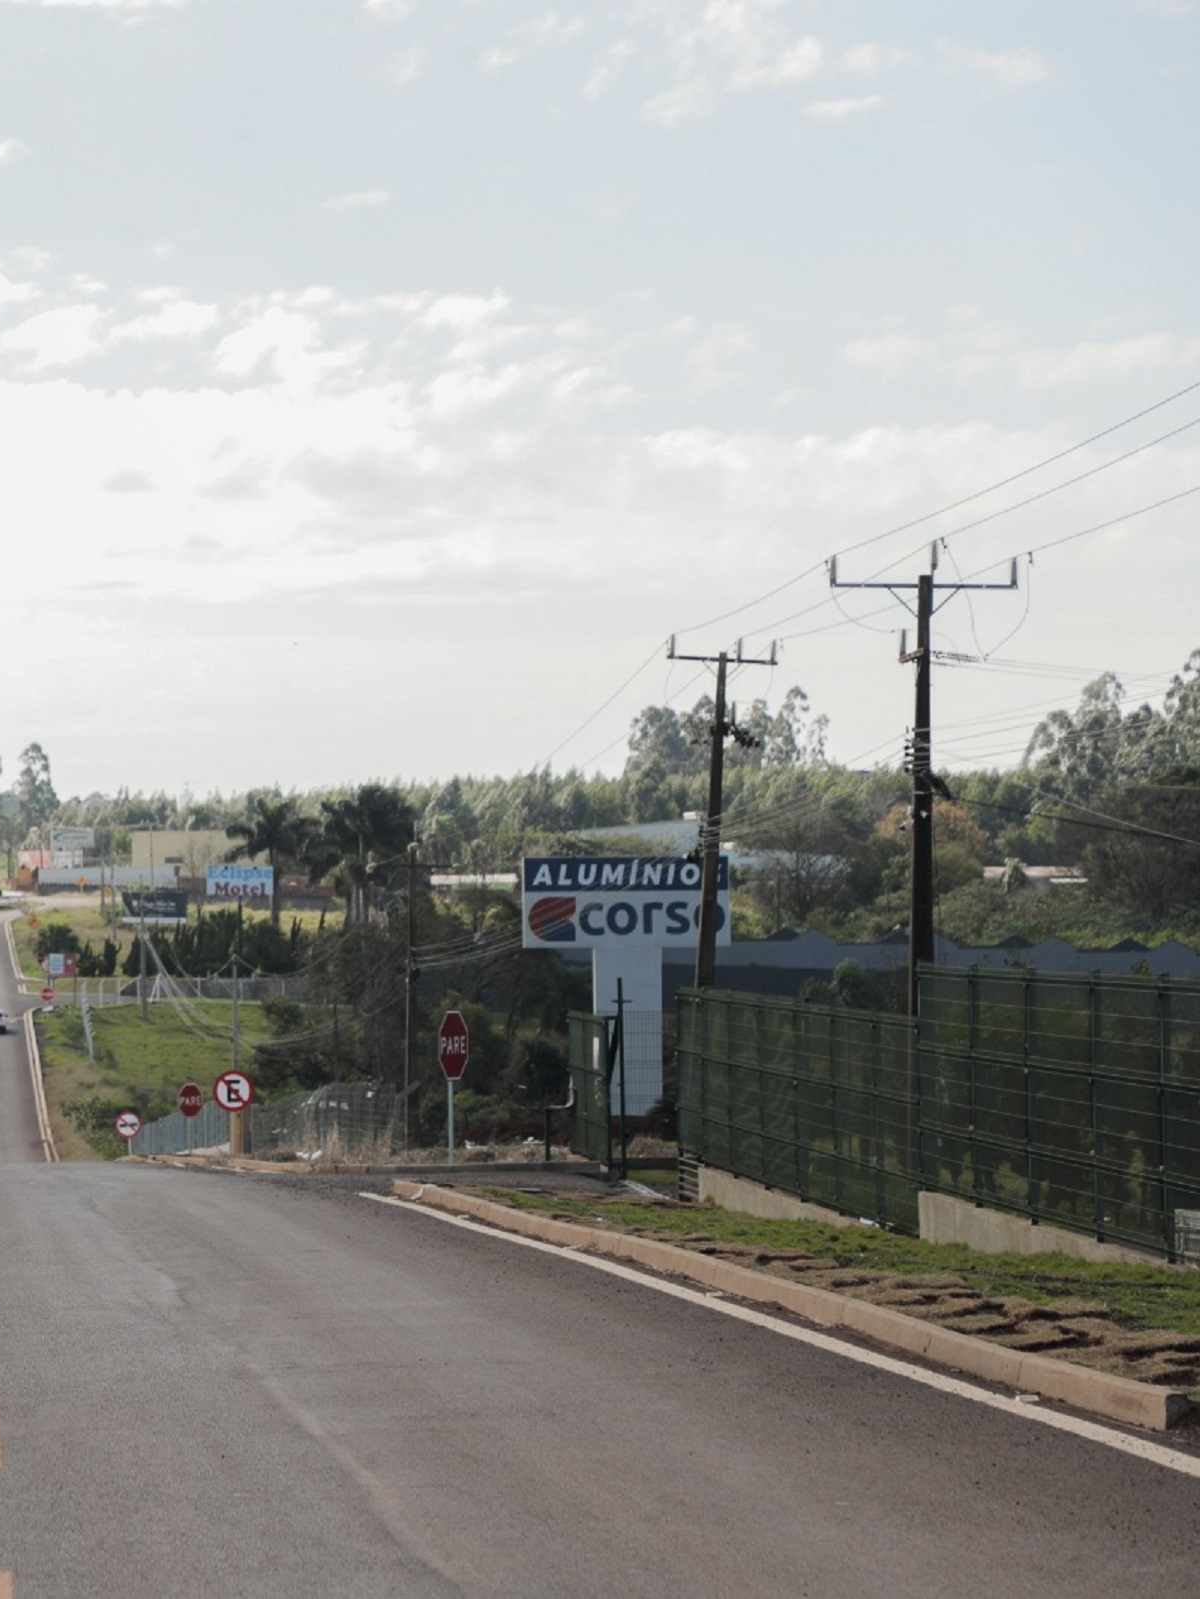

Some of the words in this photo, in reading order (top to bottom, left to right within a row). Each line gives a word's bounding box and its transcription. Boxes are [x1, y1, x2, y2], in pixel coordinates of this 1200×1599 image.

[208, 866, 272, 881] Eclipse
[214, 882, 265, 896] Motel
[440, 1036, 466, 1055] PARE
[179, 1096, 202, 1106] PARE
